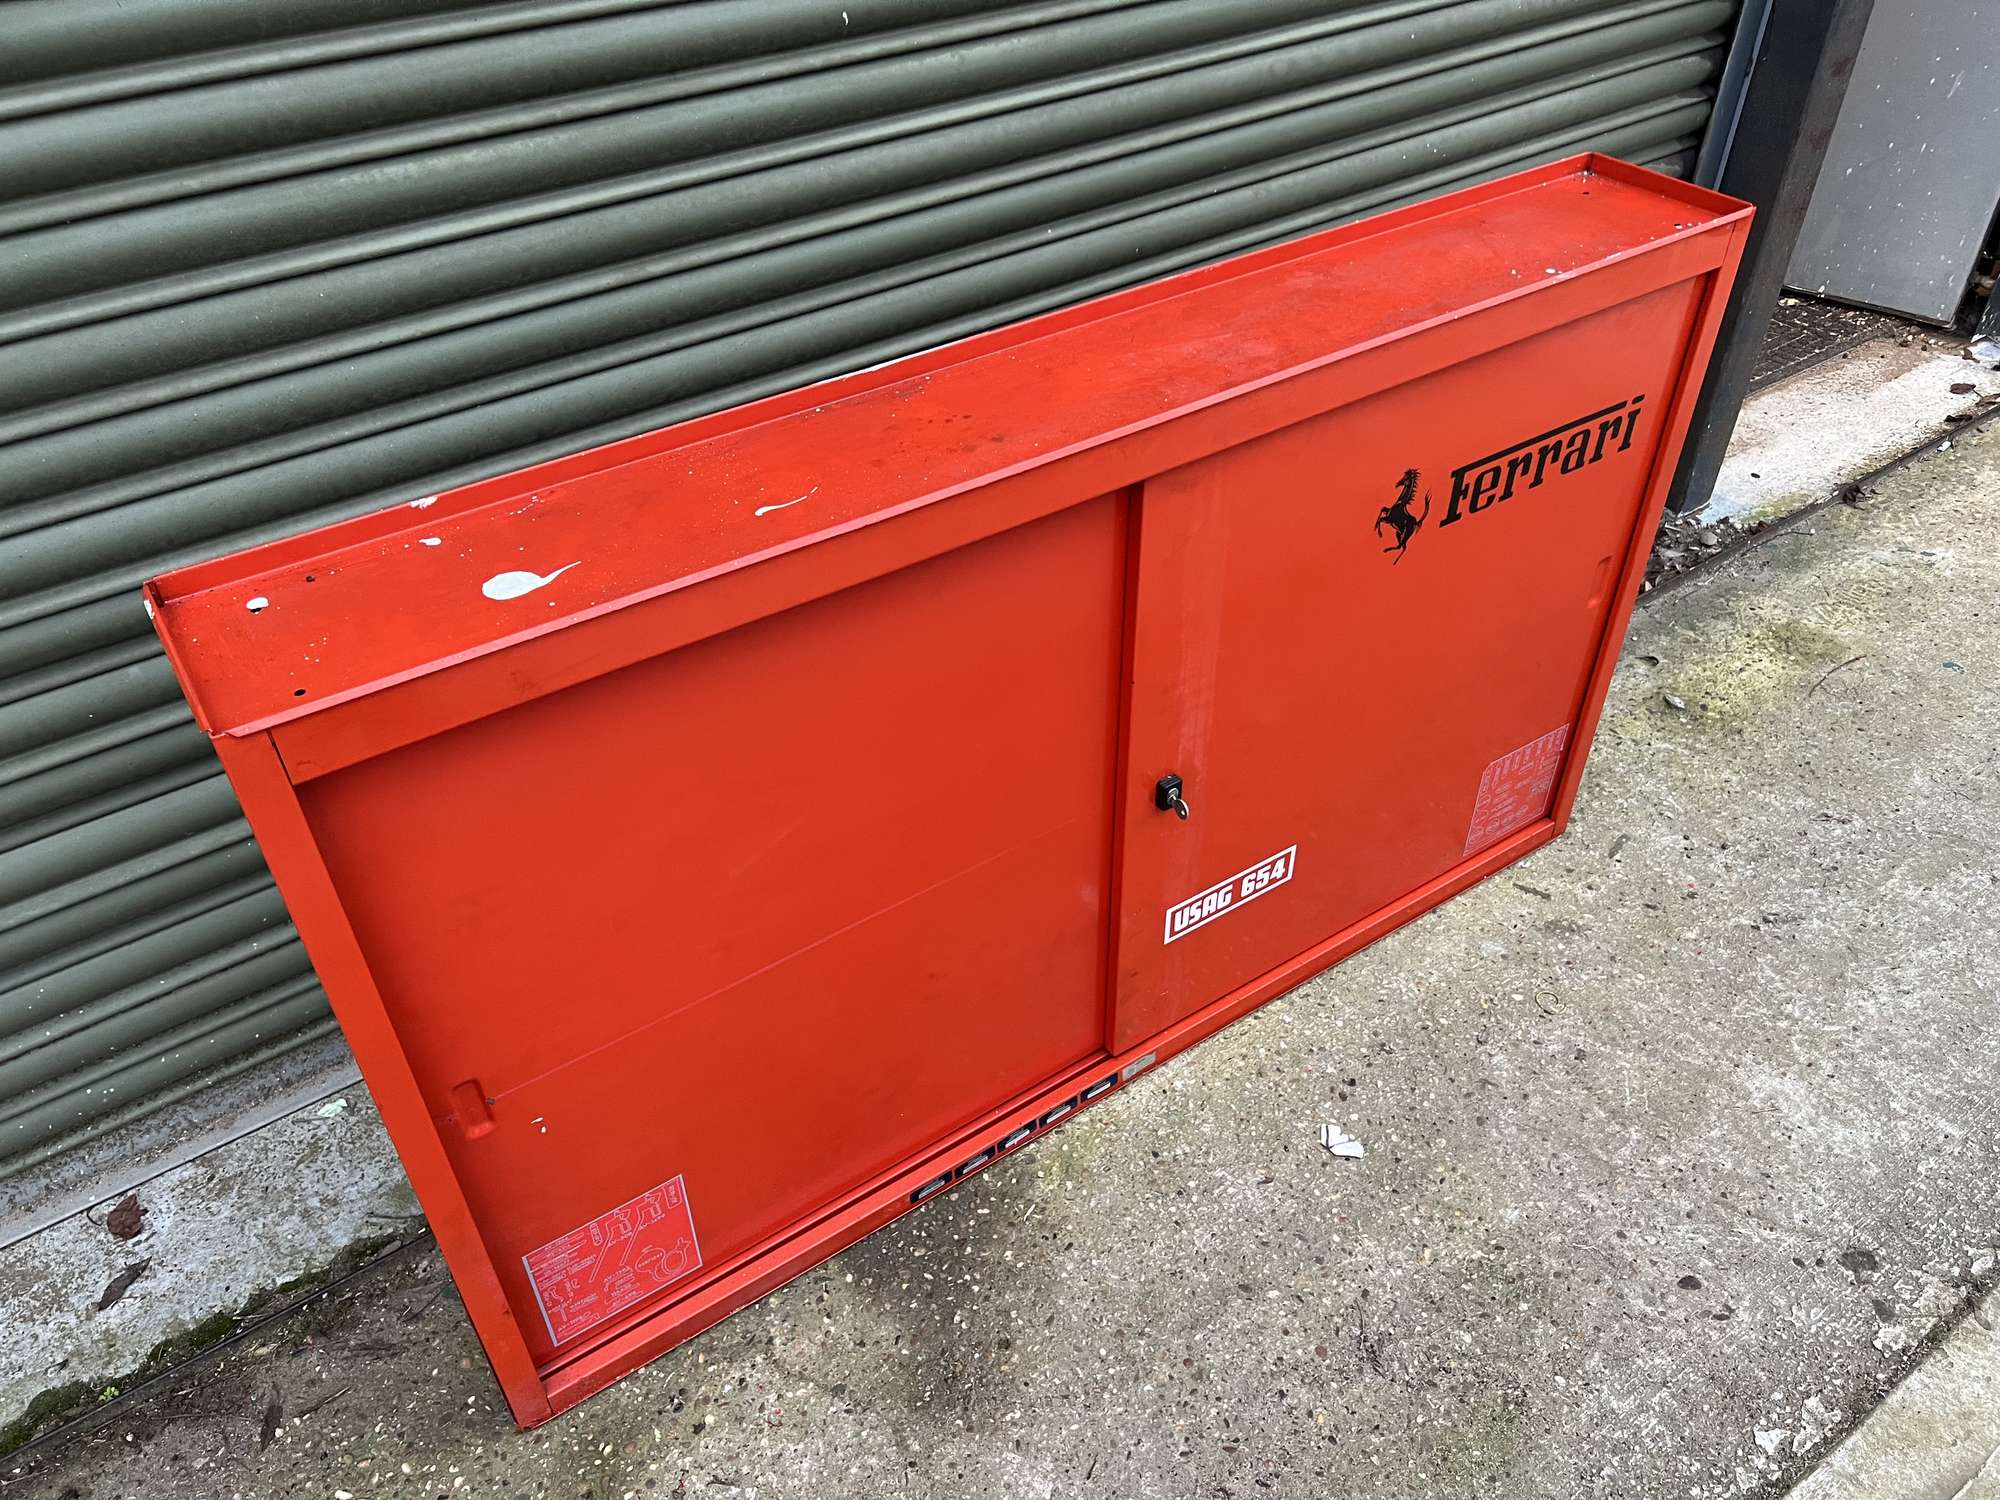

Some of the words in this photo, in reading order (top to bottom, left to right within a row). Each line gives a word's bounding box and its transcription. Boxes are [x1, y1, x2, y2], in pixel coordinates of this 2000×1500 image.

[1439, 394, 1645, 528] Ferrari
[1173, 884, 1233, 932] USAG
[1240, 857, 1286, 898] 654
